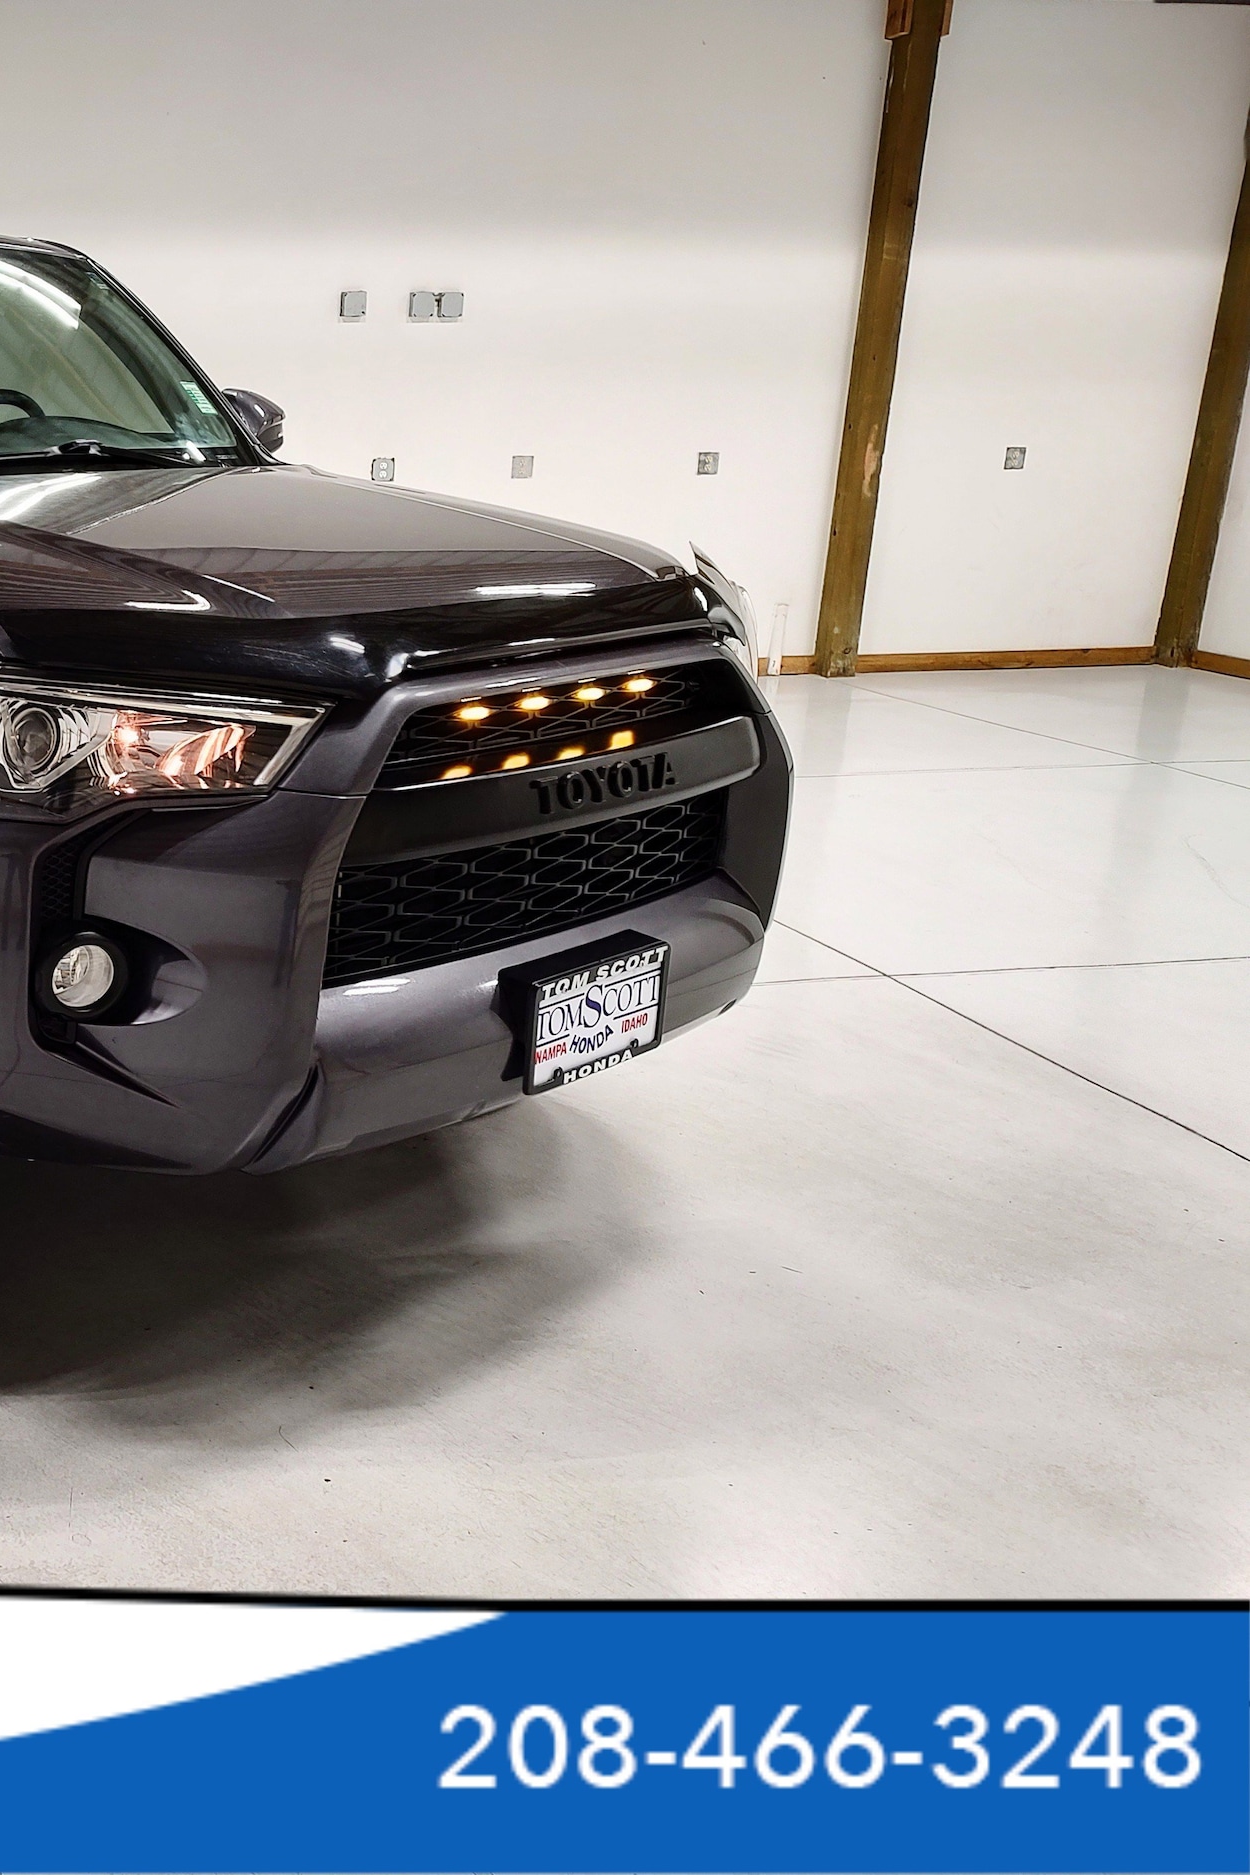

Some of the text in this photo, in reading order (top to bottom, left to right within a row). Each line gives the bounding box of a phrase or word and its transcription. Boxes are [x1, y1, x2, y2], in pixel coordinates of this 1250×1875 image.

[529, 752, 680, 815] TOYOTA
[541, 946, 668, 1000] TOM SCOTT
[534, 1013, 649, 1065] NAMPA HONDA IDAHO
[562, 1049, 634, 1085] HONDA
